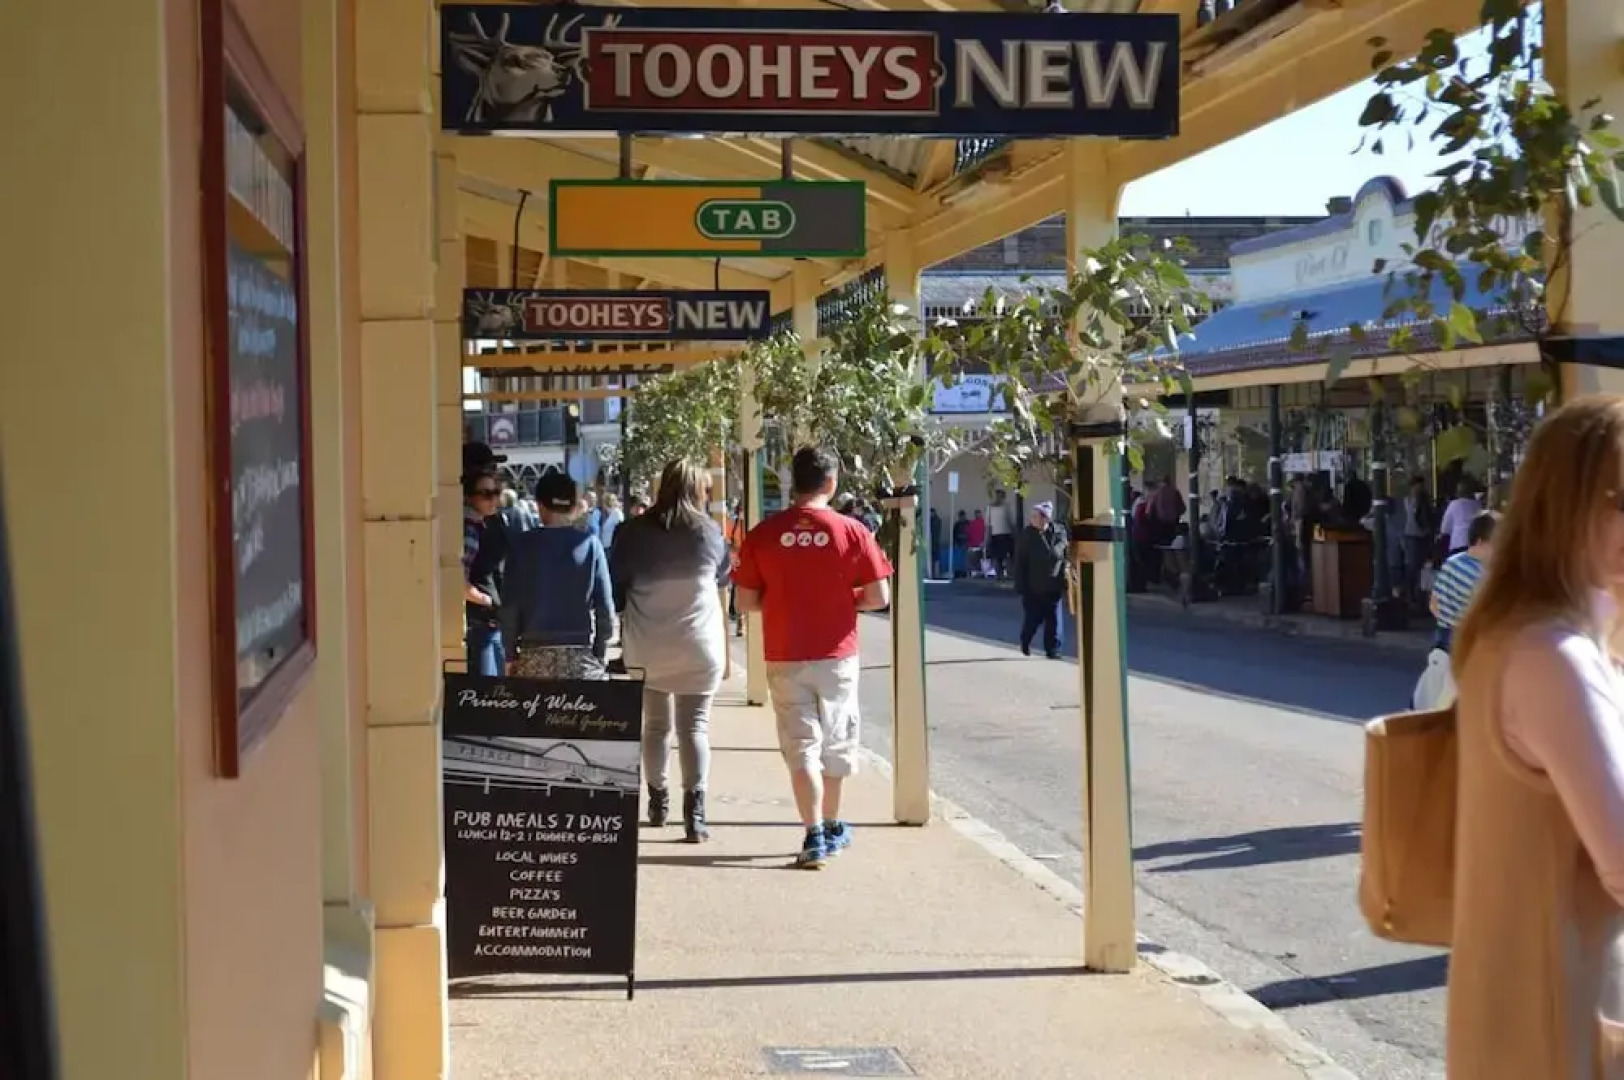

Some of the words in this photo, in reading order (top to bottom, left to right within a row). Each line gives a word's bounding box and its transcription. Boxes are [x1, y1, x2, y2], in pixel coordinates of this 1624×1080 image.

[600, 43, 922, 100] TOOHEYS
[952, 38, 1167, 110] NEW
[712, 208, 782, 230] TAB
[529, 302, 664, 328] TOOHEYS
[676, 300, 765, 330] NEW
[458, 690, 519, 708] Prince
[522, 693, 541, 718] of
[544, 693, 598, 712] Wales
[453, 810, 492, 827] PUB
[496, 812, 558, 829] MEALS
[564, 813, 576, 829] 7
[579, 814, 624, 832] DAYS
[457, 829, 497, 840] LUNCH
[535, 831, 576, 843] DINNER
[495, 850, 536, 864] LOCAL
[539, 852, 578, 865] WINES
[509, 869, 564, 883] COFFEE
[509, 887, 561, 901] PIZZA'S
[491, 906, 525, 919] BEER
[527, 907, 578, 920] GARDEN
[478, 924, 588, 939] ENTERTAINMENT
[474, 944, 592, 959] ACCOMMODATION
